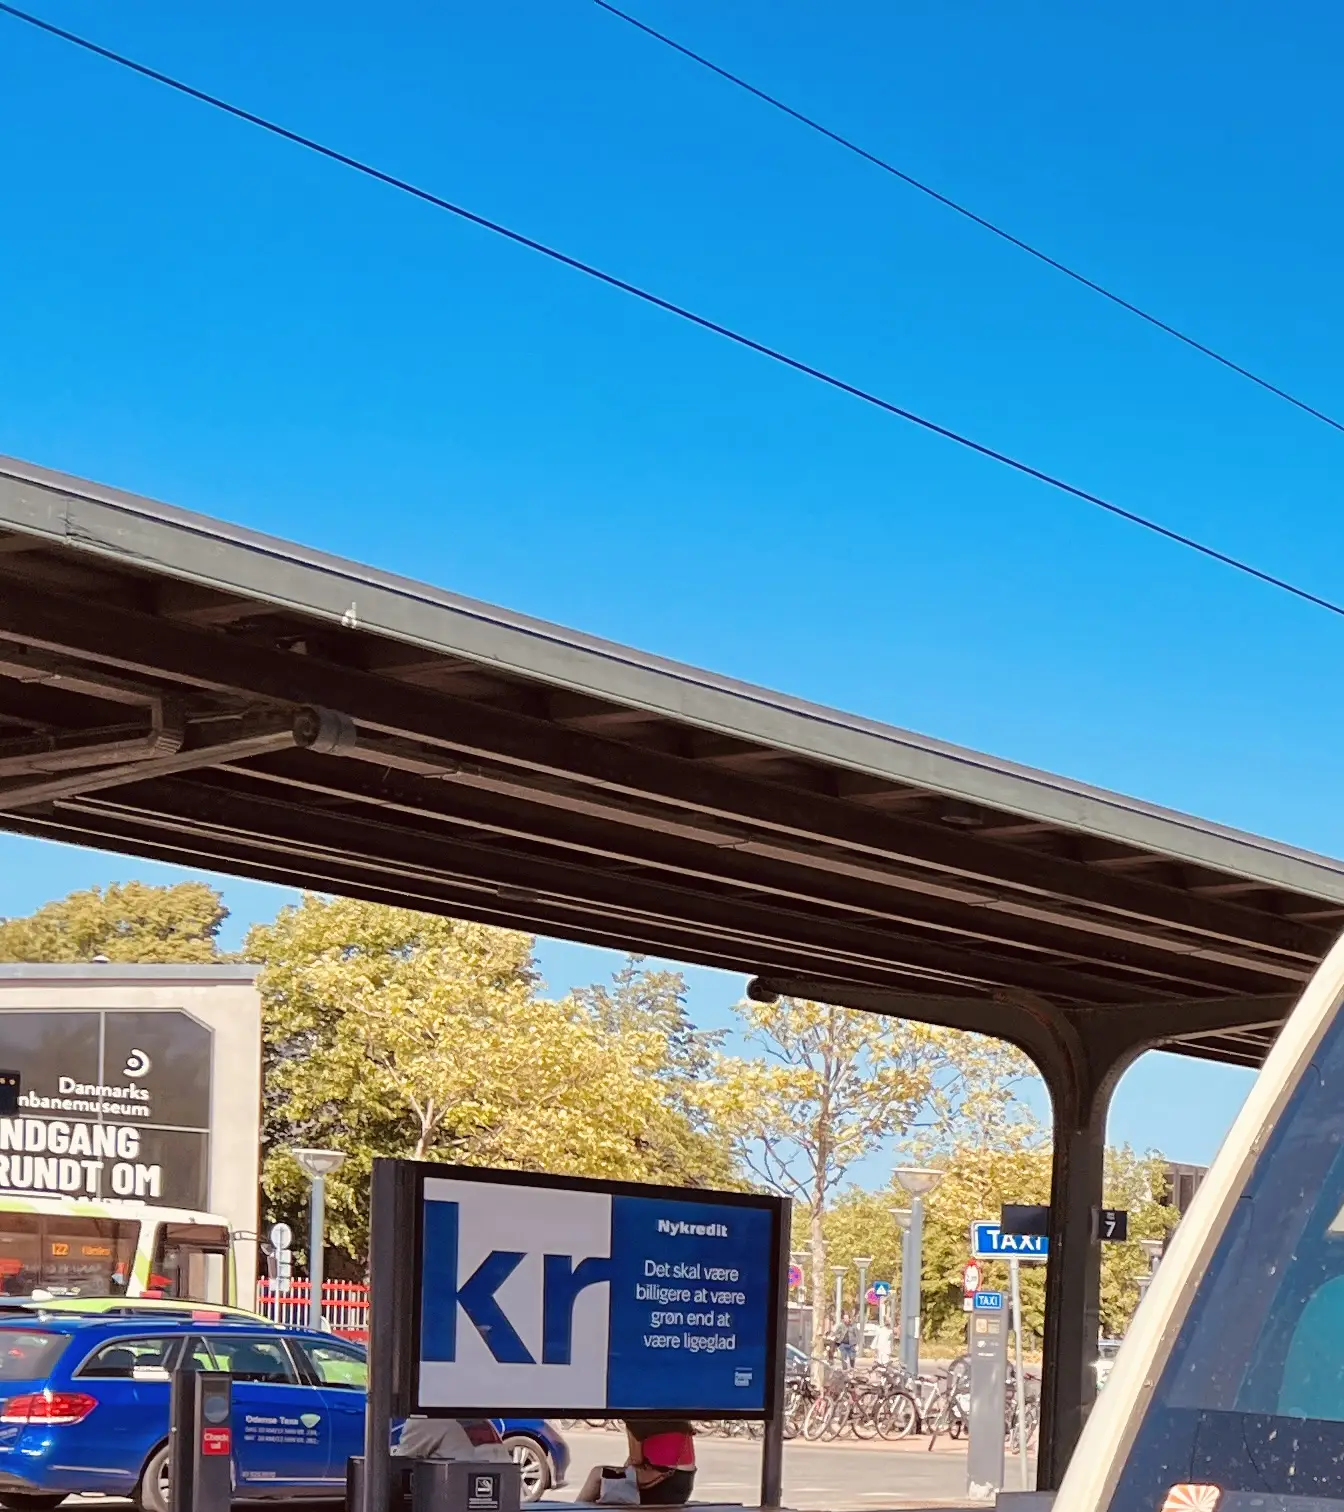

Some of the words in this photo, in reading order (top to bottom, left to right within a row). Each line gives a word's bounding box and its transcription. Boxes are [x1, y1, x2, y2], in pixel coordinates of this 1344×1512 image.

[58, 1075, 150, 1100] Danmarks
[111, 1162, 162, 1198] OM
[657, 1219, 728, 1237] Nykredit
[1104, 1220, 1117, 1238] 7
[986, 1229, 1042, 1251] TAXI
[645, 1260, 671, 1278] Det
[673, 1262, 701, 1280] skal
[703, 1267, 739, 1282] være
[421, 1200, 611, 1366] kr
[636, 1283, 691, 1305] billigere
[693, 1288, 708, 1304] at
[710, 1291, 746, 1305] være
[978, 1295, 998, 1307] TAXI
[650, 1311, 684, 1328] grøn
[686, 1310, 715, 1327] end
[717, 1312, 731, 1328] at
[643, 1334, 681, 1349] være
[684, 1332, 736, 1353] ligeglad
